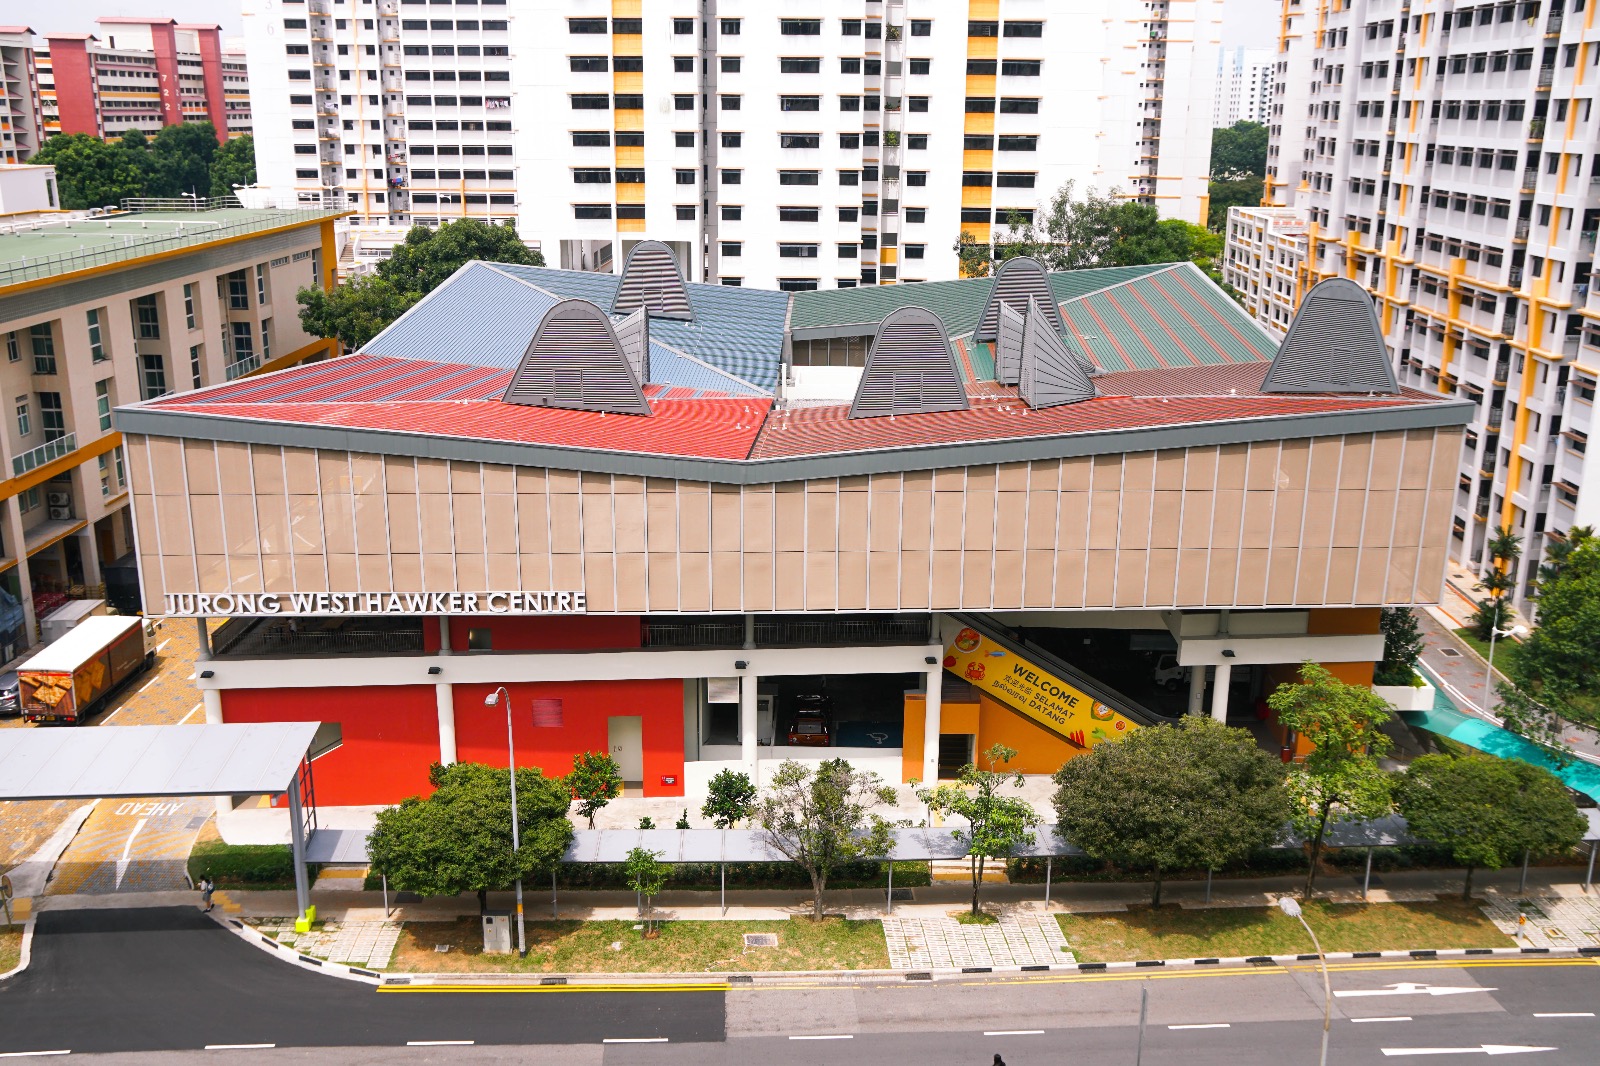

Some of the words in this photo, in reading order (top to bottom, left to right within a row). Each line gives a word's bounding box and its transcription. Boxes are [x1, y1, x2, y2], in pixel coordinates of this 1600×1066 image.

[161, 74, 171, 111] 722
[165, 593, 281, 614] JURONG
[290, 593, 358, 614] WEST
[366, 592, 480, 613] HAWKER
[487, 592, 587, 613] CENTRE
[1013, 663, 1080, 708] WELCOME
[1028, 700, 1066, 725] DATANG
[1034, 692, 1075, 719] SELAMAT
[114, 802, 185, 816] AHEAD
